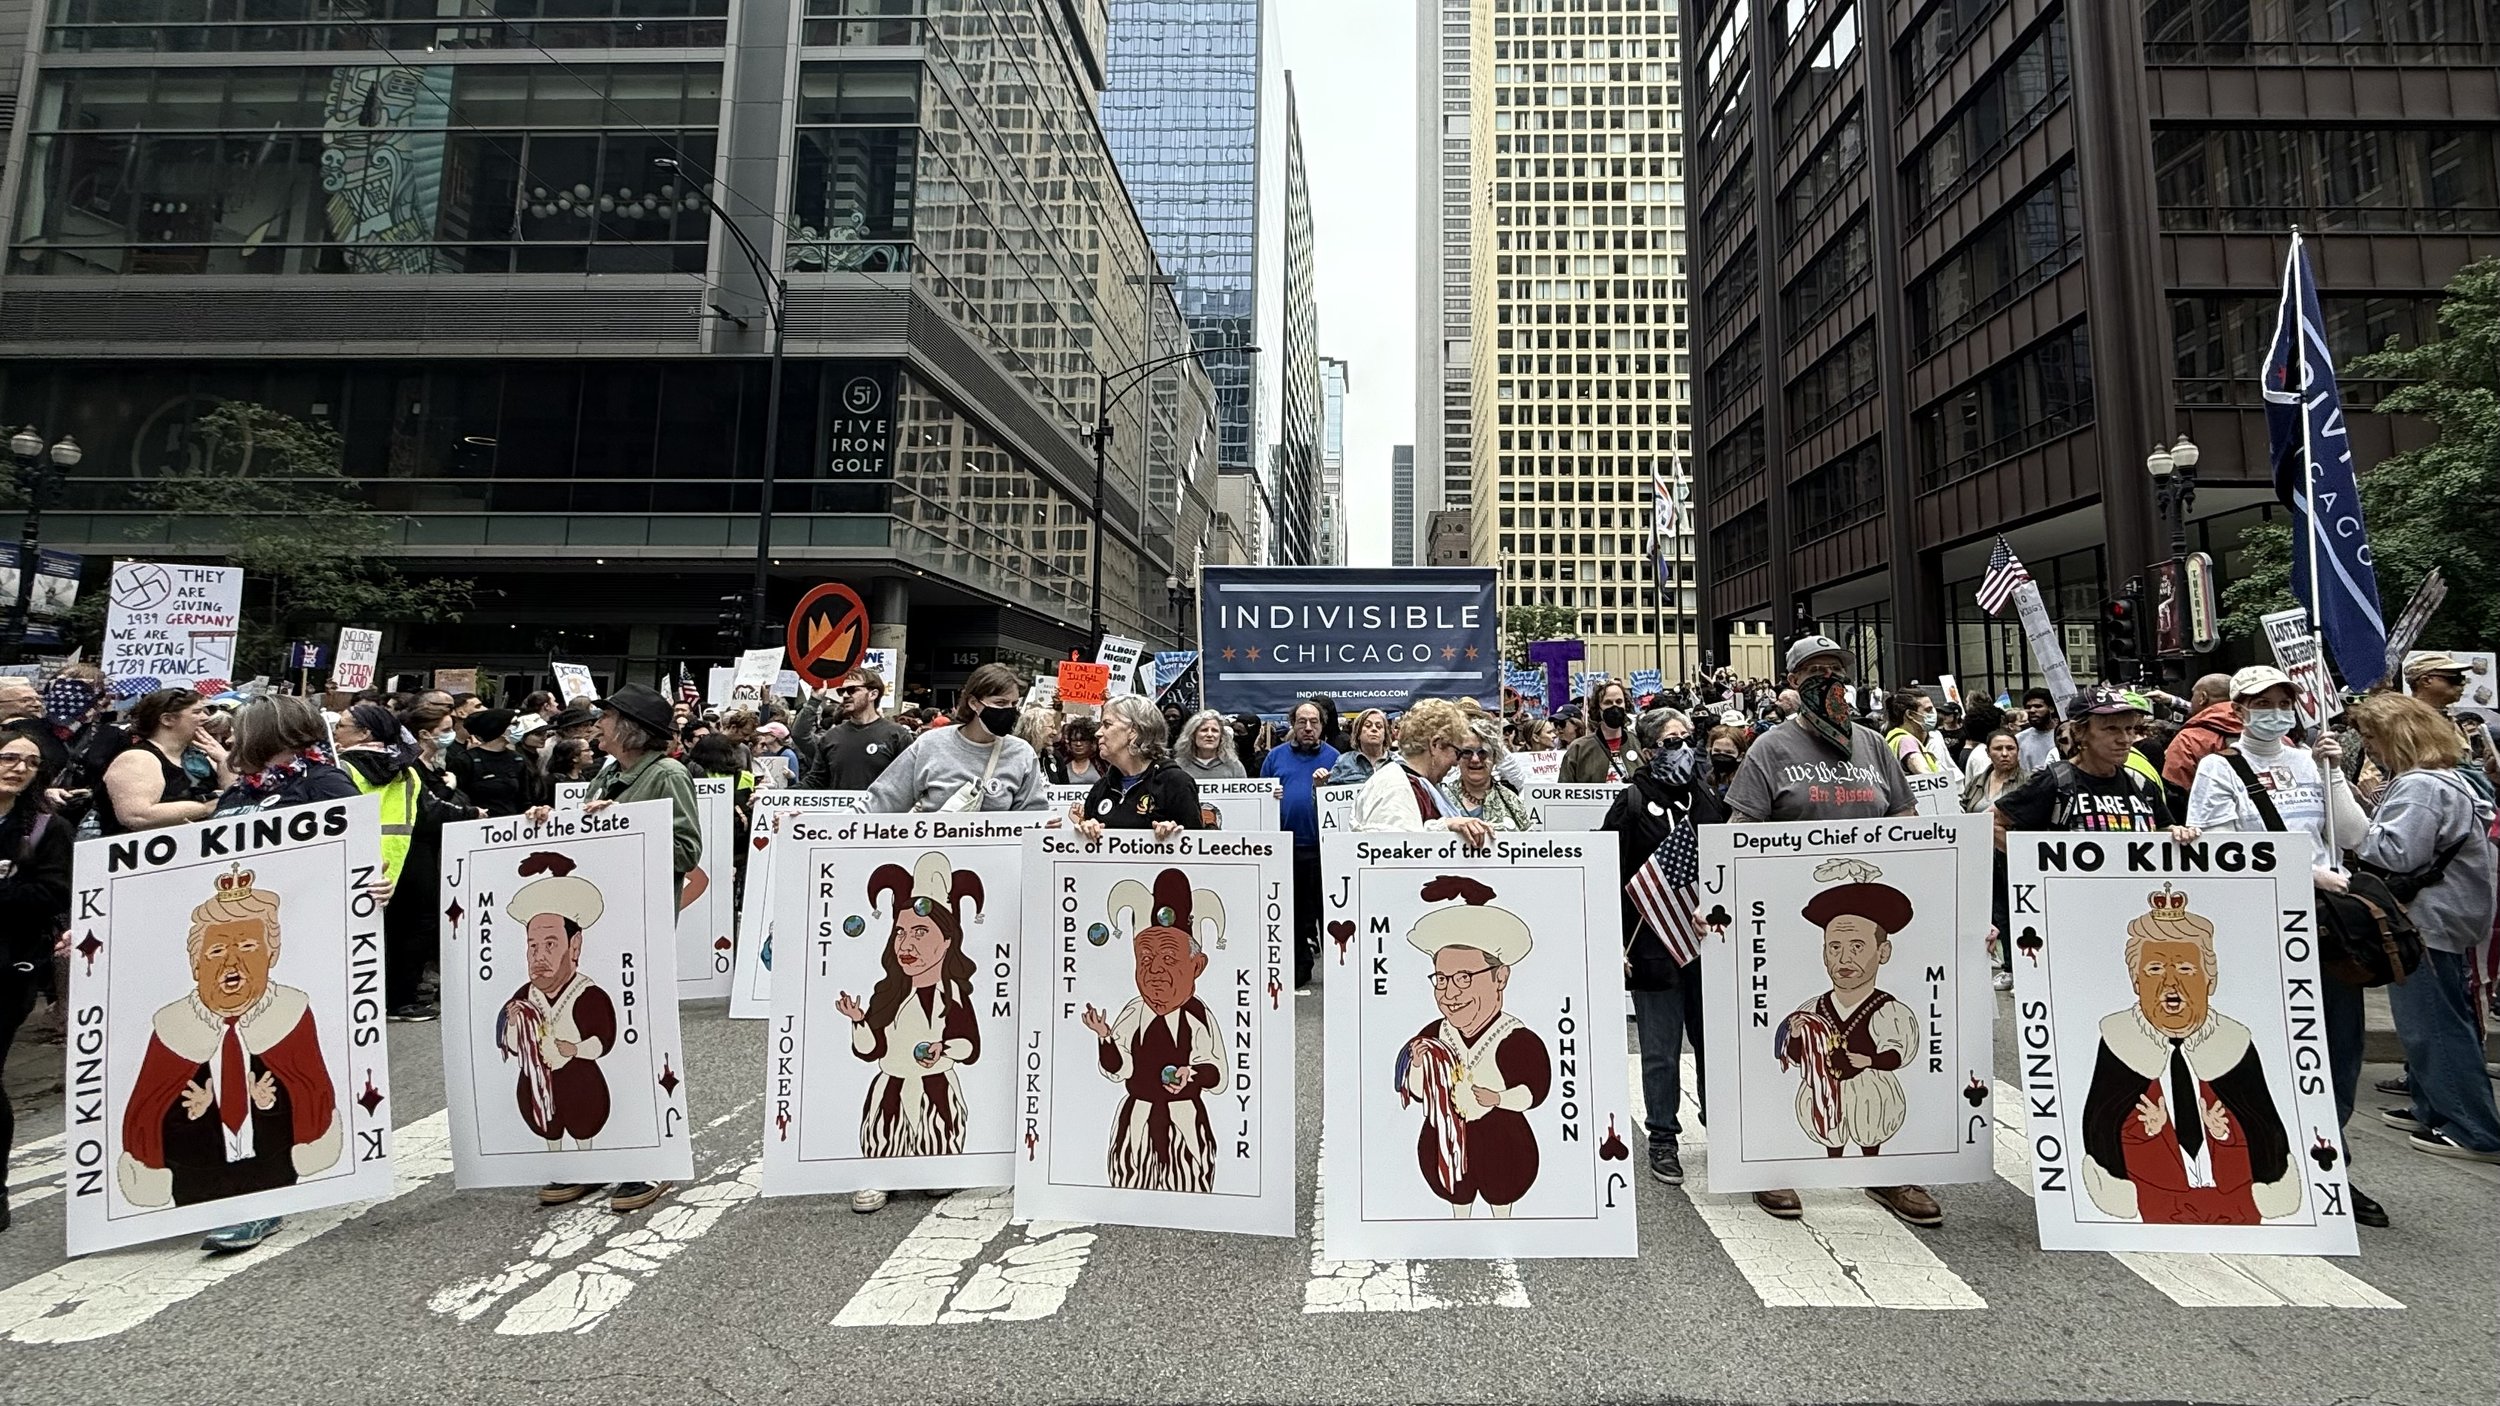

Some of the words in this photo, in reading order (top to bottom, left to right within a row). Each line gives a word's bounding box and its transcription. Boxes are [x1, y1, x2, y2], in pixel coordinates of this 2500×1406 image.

[833, 420, 887, 433] FIVE
[832, 438, 885, 452] IRON
[831, 458, 884, 472] GOLF
[177, 569, 226, 584] THEY
[172, 601, 223, 613] GIVING
[177, 587, 207, 598] ARE
[2191, 570, 2203, 638] THEATRE
[127, 613, 158, 625] 1939
[165, 613, 235, 627] GERMANY
[1220, 605, 1481, 629] INDIVISIBLE
[110, 628, 137, 640] WE
[144, 630, 169, 640] ARE
[116, 642, 185, 656] SERVING
[1816, 637, 1830, 647] C
[952, 653, 979, 665] 145
[1104, 644, 1138, 656] ILLINOIS
[1104, 653, 1133, 665] HIGHER
[1272, 643, 1433, 663] CHICAGO
[106, 659, 145, 676] 1789
[150, 657, 210, 675] FRANCE
[340, 676, 368, 688] LAND
[1108, 672, 1126, 682] ABOR
[732, 690, 759, 701] KINGS
[1530, 753, 1557, 763] TRUMP
[1783, 763, 1815, 785] We
[1814, 761, 1839, 783] the
[1837, 760, 1883, 786] People
[563, 788, 586, 799] OU
[761, 796, 790, 806] OUR
[1222, 782, 1273, 794] HEROES
[1325, 791, 1354, 803] OUR
[1532, 788, 1562, 800] OUR
[1322, 811, 1337, 829] A
[1530, 807, 1543, 825] A
[2093, 795, 2129, 814] ARE
[481, 825, 518, 845] Tool
[522, 823, 543, 840] of
[546, 817, 575, 837] the
[580, 813, 630, 834] State
[754, 813, 770, 831] A
[792, 823, 833, 841] Sec.
[838, 821, 858, 840] of
[863, 822, 909, 840] Hate
[914, 821, 928, 839] &
[1733, 831, 1802, 853] Deputy
[1807, 827, 1858, 847] Chief
[1863, 825, 1883, 844] of
[1888, 822, 1957, 844] Cruelty
[107, 834, 177, 872] NO
[200, 806, 348, 858] KINGS
[1042, 836, 1080, 855] Sec.
[1085, 836, 1103, 854] of
[1108, 836, 1175, 856] Potions
[1179, 837, 1193, 855] &
[1198, 837, 1273, 857] Leeches
[1357, 842, 1435, 865] Speaker
[1438, 841, 1460, 859] of
[1462, 842, 1492, 859] the
[1497, 842, 1582, 865] Spineless
[2038, 841, 2106, 872] NO
[2128, 841, 2277, 872] KINGS
[447, 858, 464, 888] J
[1704, 864, 1726, 895] J
[79, 888, 107, 919] K
[351, 865, 377, 920] NO
[1329, 876, 1351, 909] J
[2013, 883, 2040, 914] K
[818, 863, 835, 977] KRISTI
[1063, 877, 1077, 994] ROBERT
[1266, 881, 1281, 987] JOKER
[478, 891, 494, 981] MARCO
[2282, 909, 2310, 963] NO
[1370, 916, 1390, 996] MIKE
[1752, 900, 1768, 1028] STEPHEN
[352, 930, 379, 1049] KINGS
[991, 943, 1012, 1018] NOEM
[621, 952, 639, 1045] RUBIO
[1063, 1002, 1076, 1020] F
[1925, 965, 1945, 1074] MILLER
[1236, 969, 1251, 1113] KENNEDY
[2287, 978, 2326, 1097] KINGS
[76, 1004, 104, 1123] KINGS
[775, 1015, 795, 1118] JOKER
[1557, 997, 1579, 1143] JOHNSON
[2022, 1000, 2057, 1119] KINGS
[1026, 1030, 1041, 1140] JOKER
[664, 1107, 683, 1138] J
[1965, 1114, 1988, 1145] J
[359, 1127, 387, 1163] K
[1236, 1119, 1250, 1160] JR
[76, 1139, 103, 1198] NO
[2036, 1134, 2067, 1192] NO
[1604, 1172, 1628, 1208] J
[2314, 1182, 2347, 1217] K
